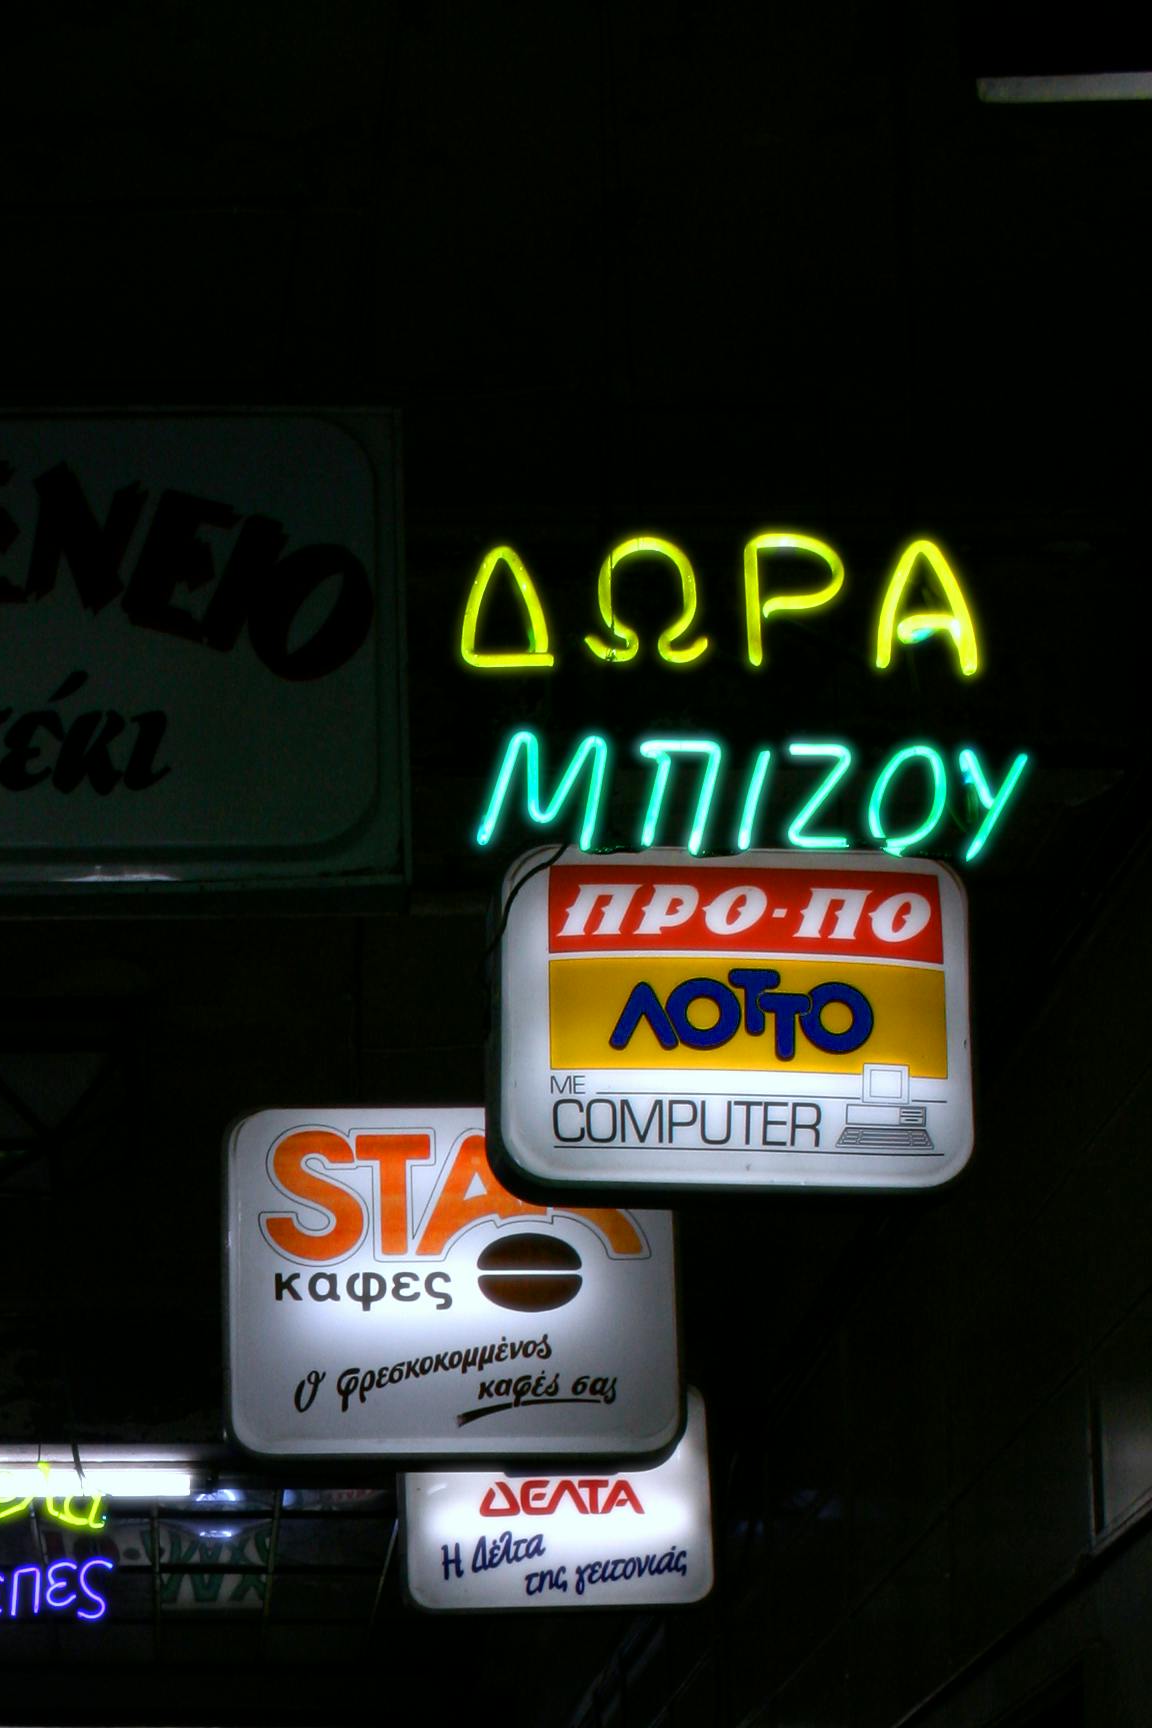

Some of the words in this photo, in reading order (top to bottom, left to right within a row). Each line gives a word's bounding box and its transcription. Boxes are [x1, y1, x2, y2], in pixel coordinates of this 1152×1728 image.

[460, 530, 980, 678] ΔΩΡΑ
[472, 728, 1032, 864] ΜΠΙΖΟΥ
[556, 883, 932, 943] ΠΡΟ-ΠΟ
[608, 968, 875, 1062] ΛΟΤΤΟ
[549, 1075, 586, 1095] ΜΕ
[552, 1098, 822, 1148] COMPUTER
[265, 1130, 643, 1260] STA
[274, 1270, 453, 1311] καφες
[337, 1334, 552, 1412] φρεσκοκομμένος
[478, 1370, 559, 1408] καφές
[571, 1376, 618, 1404] σας
[479, 1479, 645, 1517] ΔΕΛΤΑ
[441, 1542, 464, 1580] Η
[471, 1530, 546, 1573] Δέλτα
[525, 1564, 568, 1596] της
[575, 1545, 688, 1595] γειτονιάς
